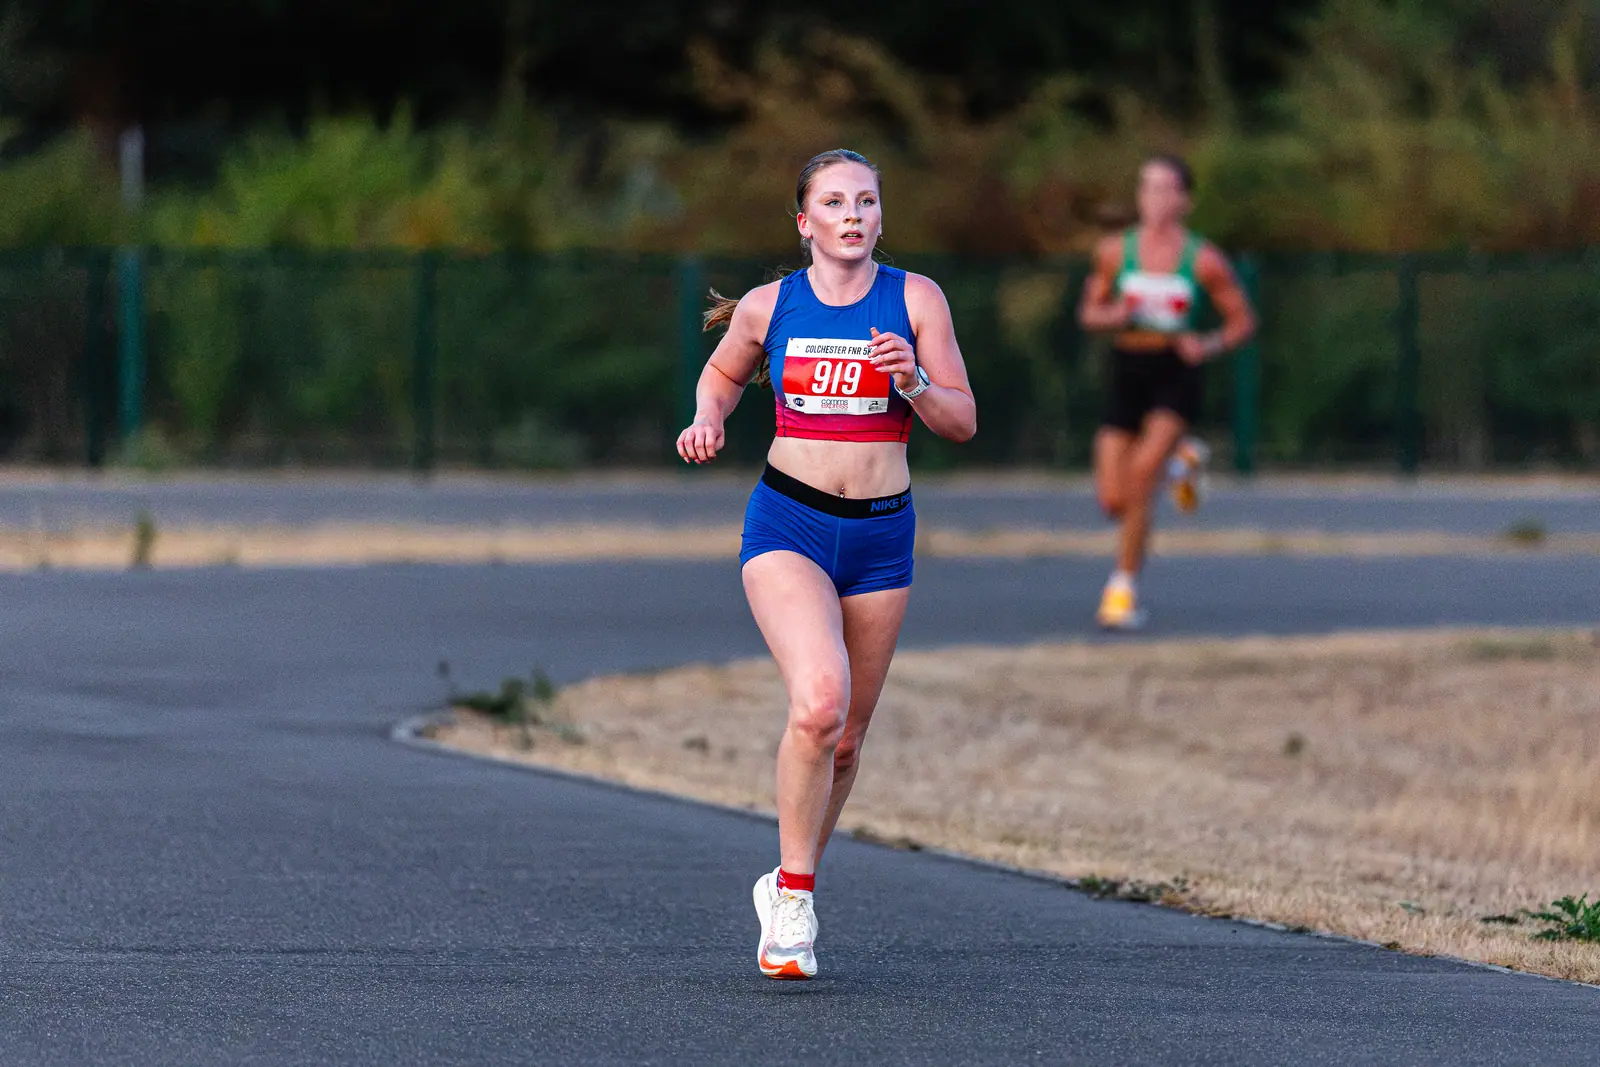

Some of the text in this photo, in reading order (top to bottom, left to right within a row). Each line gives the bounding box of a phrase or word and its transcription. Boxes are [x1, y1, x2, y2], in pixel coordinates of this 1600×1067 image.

[805, 345, 847, 355] COLCHESTER
[848, 346, 862, 355] FNR
[812, 360, 862, 395] 919
[871, 492, 911, 512] NIKE PR
